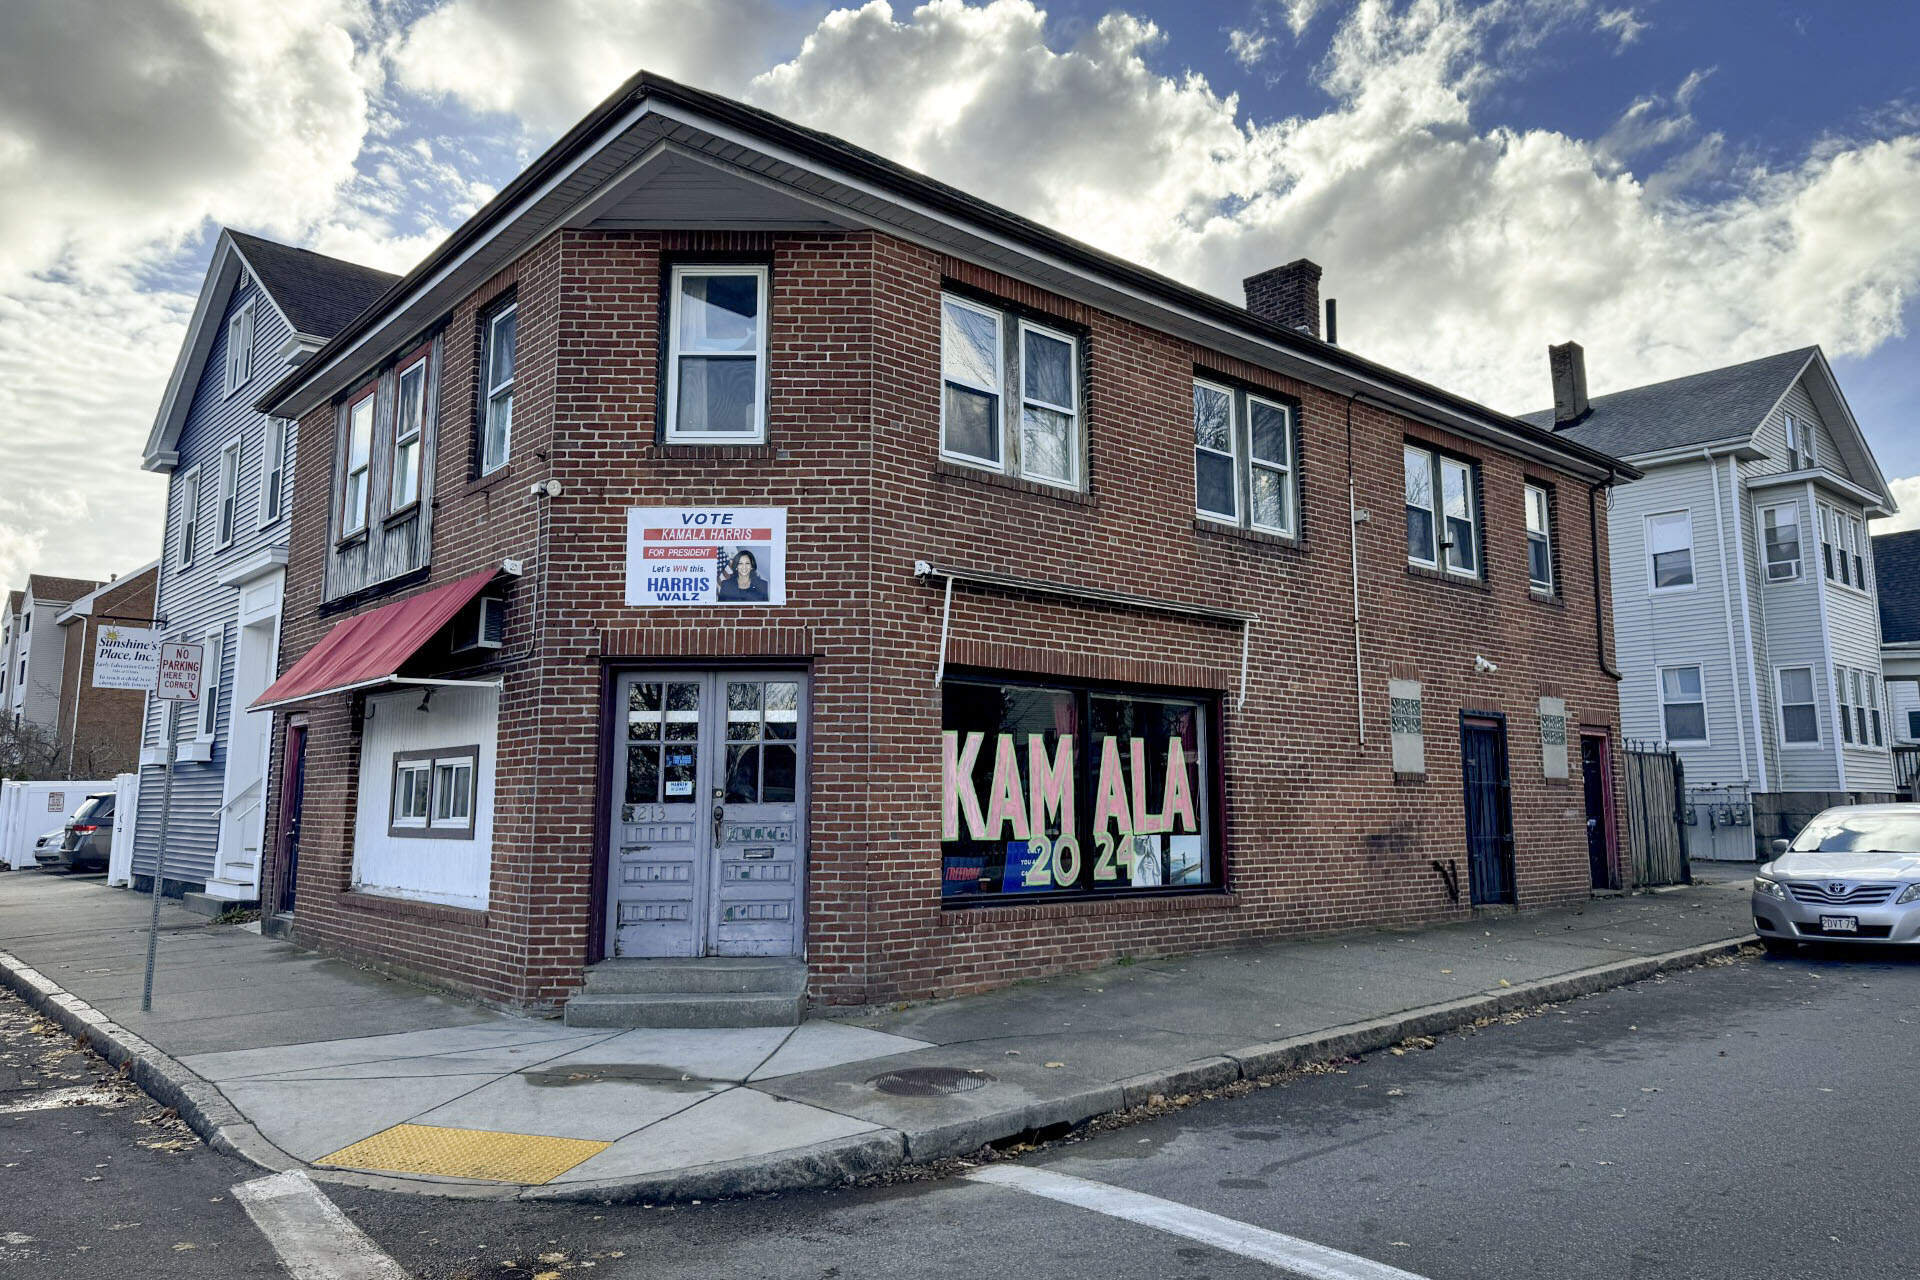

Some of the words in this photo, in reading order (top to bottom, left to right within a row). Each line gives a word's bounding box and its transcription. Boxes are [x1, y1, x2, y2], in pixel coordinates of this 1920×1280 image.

[682, 513, 734, 525] VOTE
[661, 528, 706, 540] KAMALA
[710, 528, 753, 540] HARRIS
[648, 549, 664, 557] FOR
[668, 549, 711, 557] PRESIDENT
[652, 565, 670, 573] Let's
[690, 565, 706, 573] this.
[647, 577, 710, 592] HARRIS
[656, 592, 700, 601] WALZ
[98, 637, 158, 651] Sunshine's
[134, 651, 154, 662] Inc.
[176, 649, 189, 660] NO
[162, 659, 199, 672] PARKING
[163, 671, 183, 680] HERE
[187, 672, 196, 681] TO
[164, 680, 194, 689] CORNER
[1025, 831, 1136, 887] 2024
